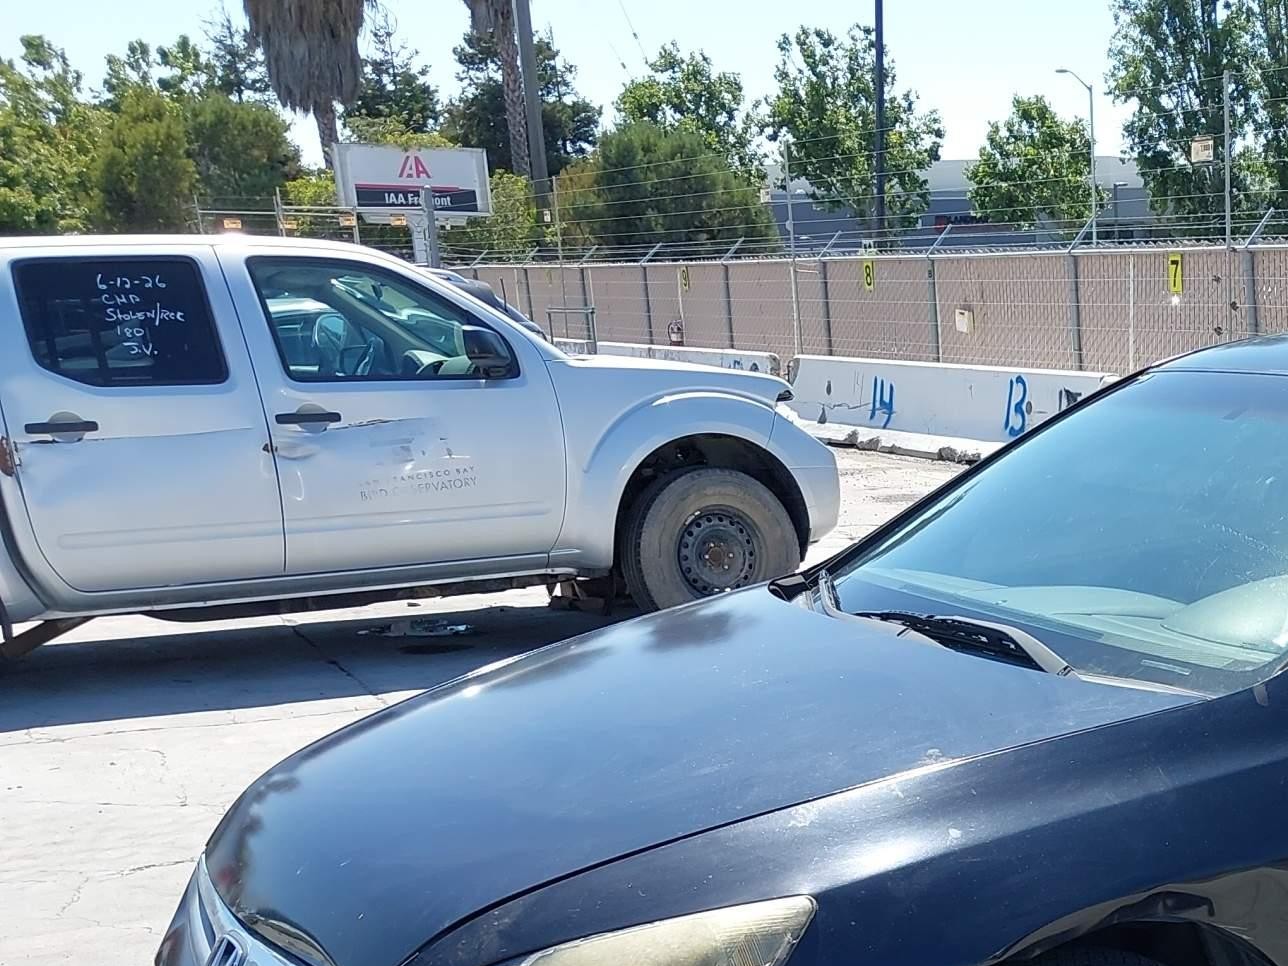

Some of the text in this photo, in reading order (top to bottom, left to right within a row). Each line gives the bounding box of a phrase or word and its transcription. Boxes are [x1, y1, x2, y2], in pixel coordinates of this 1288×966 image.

[384, 192, 406, 205] IAA
[96, 273, 167, 290] 6-12-26
[865, 264, 872, 286] 8
[1170, 260, 1179, 288] 7
[116, 325, 145, 338] 180
[869, 375, 895, 430] 14
[1004, 374, 1028, 438] 13
